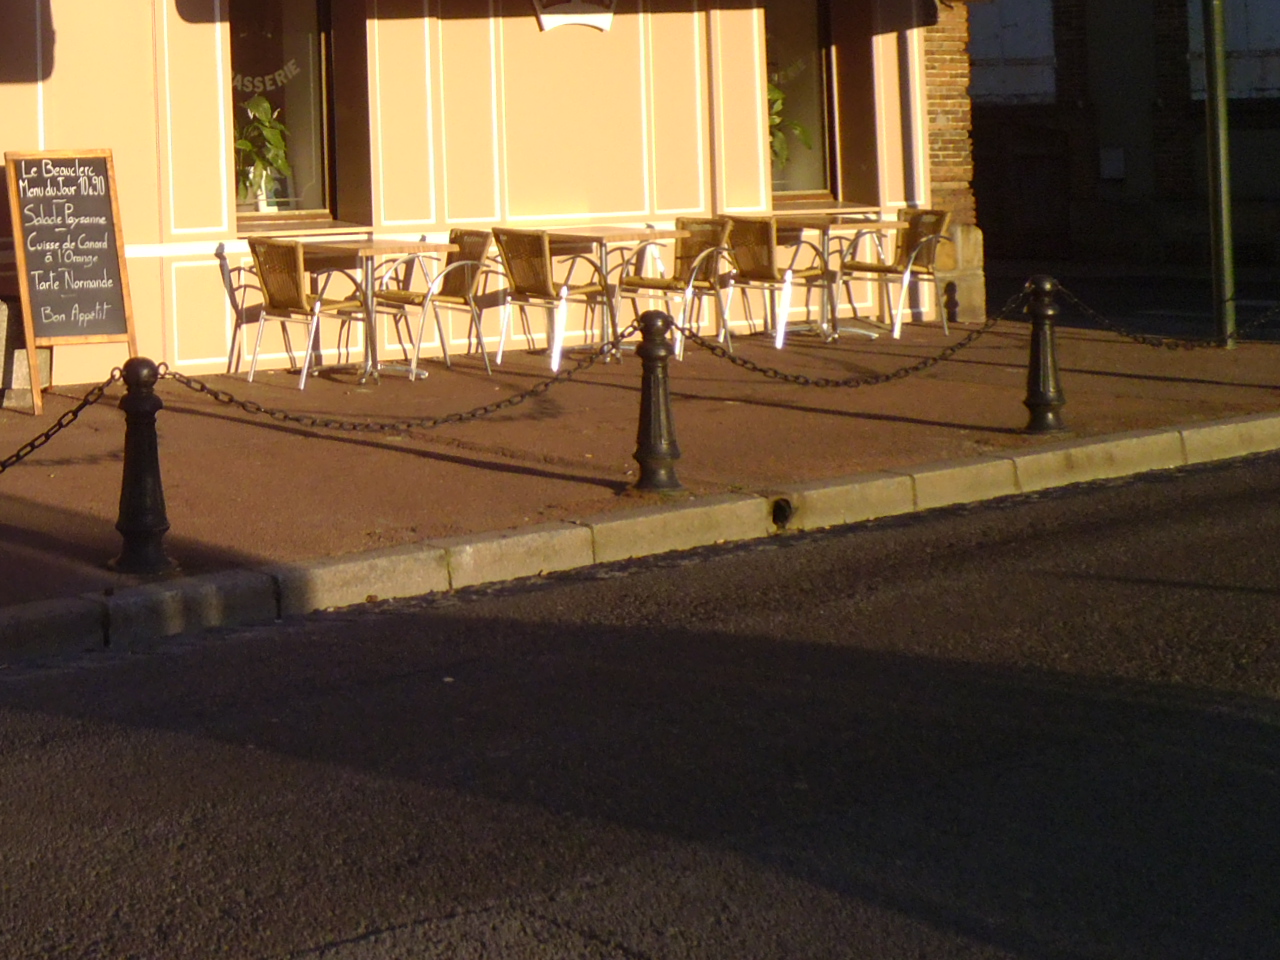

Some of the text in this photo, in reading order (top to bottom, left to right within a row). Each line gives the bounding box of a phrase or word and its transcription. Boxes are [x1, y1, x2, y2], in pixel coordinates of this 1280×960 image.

[21, 158, 95, 179] Le Beauclerc
[18, 178, 44, 198] Menu
[45, 178, 56, 196] du
[56, 177, 77, 196] Jour
[23, 203, 107, 229] Salade Paysanne
[27, 231, 108, 251] Cuisse de Canard
[57, 249, 98, 268] l'Orange
[30, 268, 113, 290] Tarte Normande
[41, 306, 66, 323] Bon
